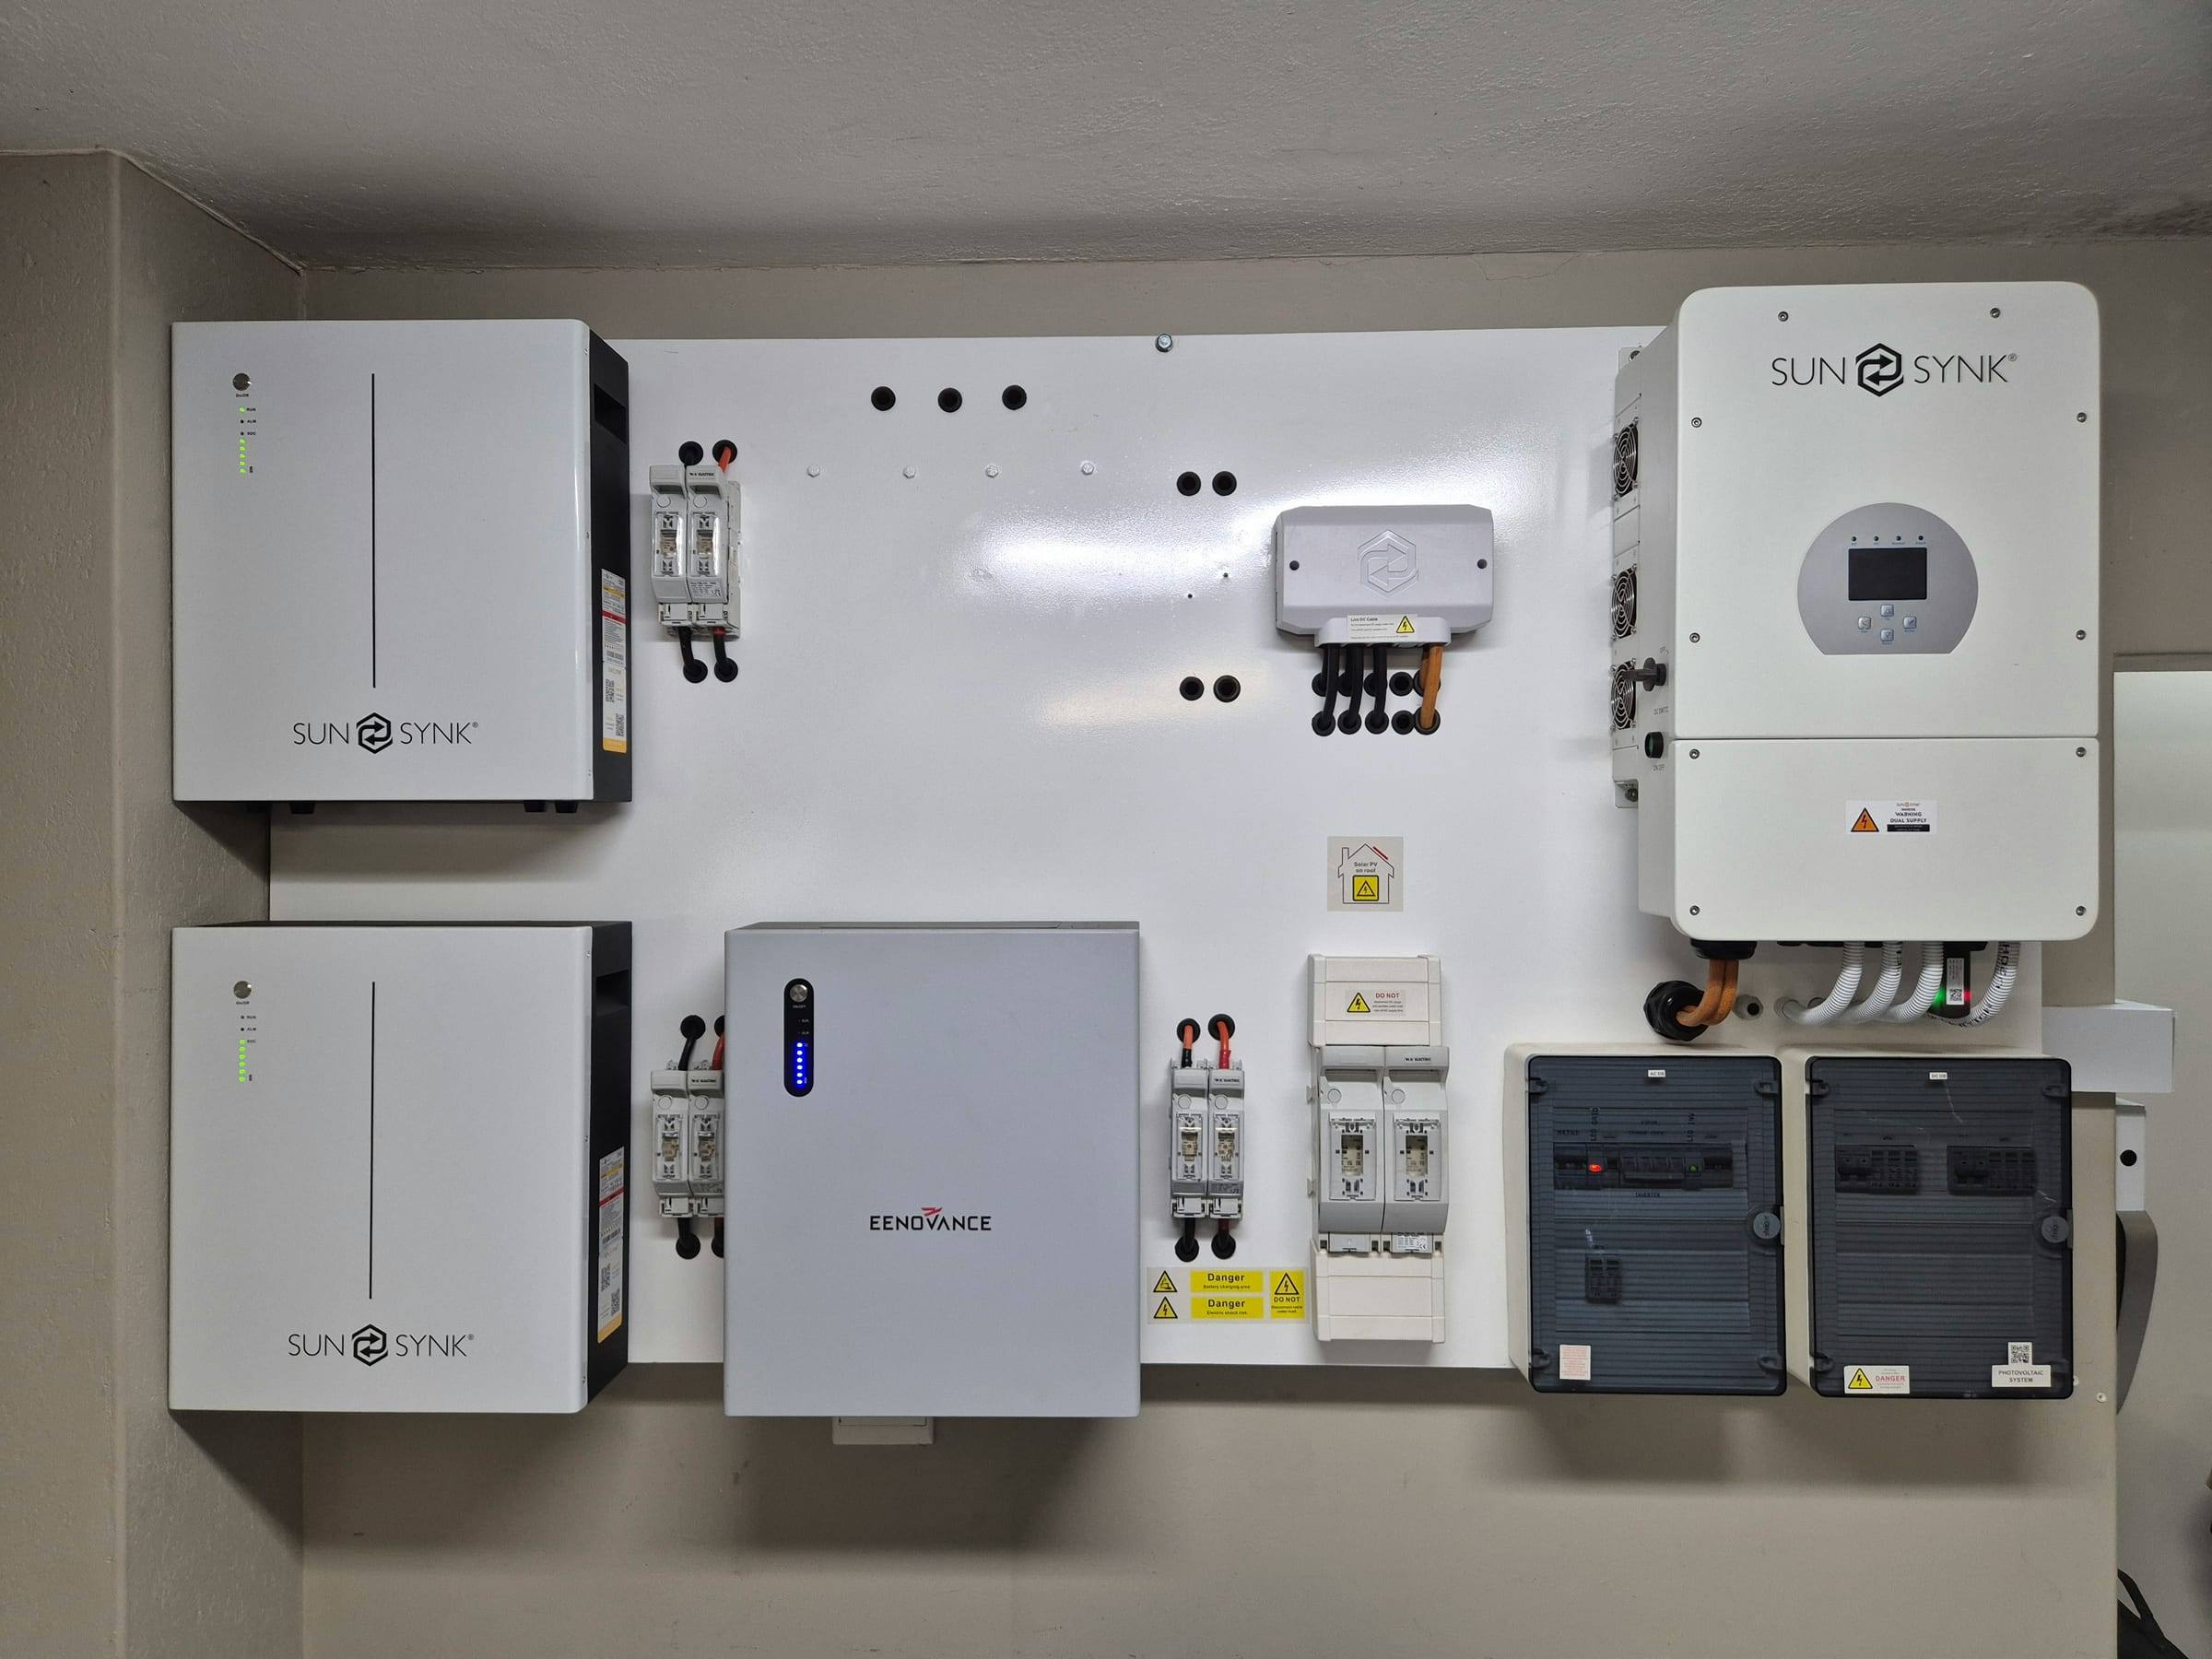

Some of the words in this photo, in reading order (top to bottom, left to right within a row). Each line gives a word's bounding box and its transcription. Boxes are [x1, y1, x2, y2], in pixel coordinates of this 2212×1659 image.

[1771, 357, 1846, 386] SUN
[293, 722, 349, 745] SUN
[869, 1214, 993, 1231] EENOVANCE
[1207, 1273, 1245, 1284] Danger
[1207, 1299, 1246, 1310] Danger
[288, 1333, 345, 1357] SUN
